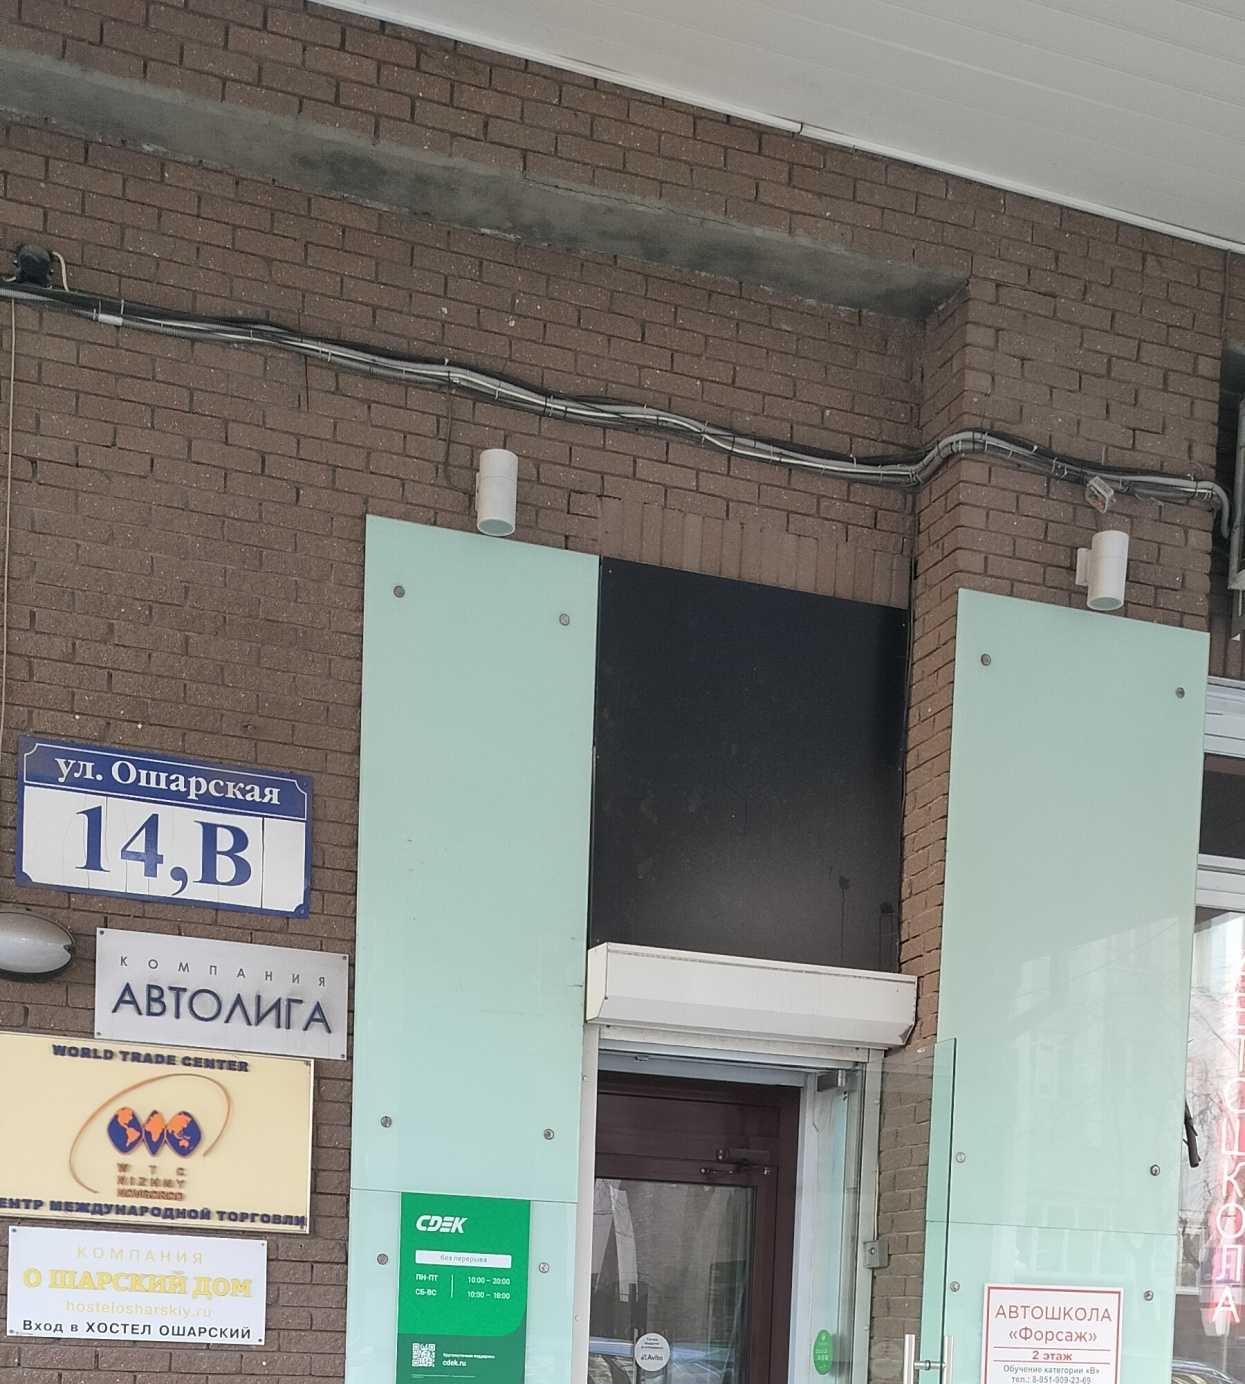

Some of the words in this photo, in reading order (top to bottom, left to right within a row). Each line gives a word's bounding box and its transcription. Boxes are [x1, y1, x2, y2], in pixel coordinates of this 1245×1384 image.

[54, 757, 103, 783] ул.
[111, 760, 281, 805] Ошарская
[75, 805, 252, 895] 14,В
[120, 955, 326, 988] КОМПАНИЯ
[112, 982, 332, 1034] АВТОЛИГА
[52, 1044, 114, 1061] WORLD
[119, 1050, 176, 1067] TRADE
[181, 1056, 249, 1073] CENTER
[50, 1200, 211, 1220] МЕЖДУНАРОДНОЙ
[216, 1210, 306, 1227] ТОРГОВЛИ
[416, 1214, 468, 1234] CDEK
[76, 1246, 204, 1265] КОМПАНИЯ
[49, 1268, 188, 1295] ШАРСКИЙ
[192, 1276, 254, 1299] ДОМ
[415, 1274, 439, 1282] ПН-ПТ
[995, 1304, 1112, 1322] АВТОШКОЛА
[23, 1319, 64, 1334] Вход
[70, 1323, 79, 1332] в
[86, 1321, 152, 1336] ХОСТЕЛ
[159, 1324, 251, 1339] ОШАРСКИЙ
[1009, 1326, 1097, 1344] «Форсаж»
[1032, 1350, 1038, 1360] 2
[1042, 1352, 1072, 1361] этаж
[1003, 1365, 1042, 1374] Обучение
[1044, 1367, 1083, 1376] категории
